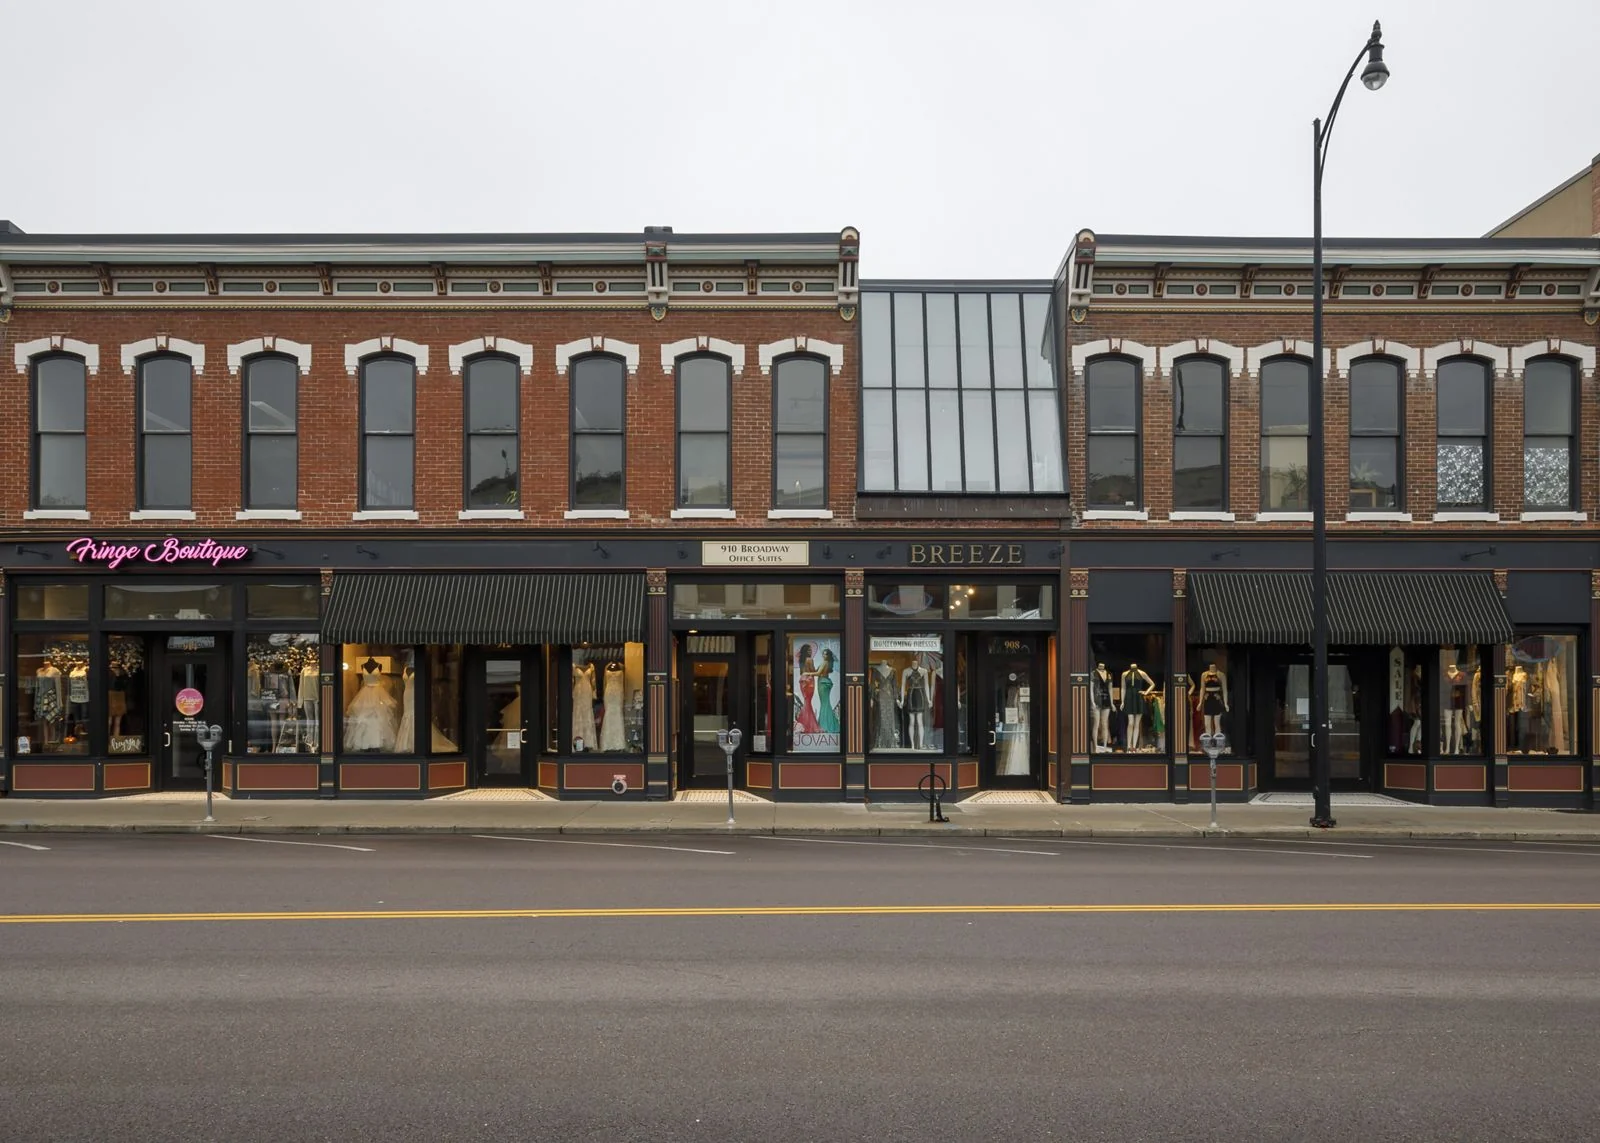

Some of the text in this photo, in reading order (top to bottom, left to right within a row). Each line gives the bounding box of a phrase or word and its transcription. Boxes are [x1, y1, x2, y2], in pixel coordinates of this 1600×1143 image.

[66, 537, 249, 569] Fringe Boutique
[720, 544, 791, 553] 910 BROADWAY
[910, 544, 1024, 564] BREEZE
[728, 554, 783, 562] OFFICE SUITES
[1004, 640, 1020, 649] 908
[1393, 658, 1402, 701] SALE
[793, 734, 839, 746] JOVAN
